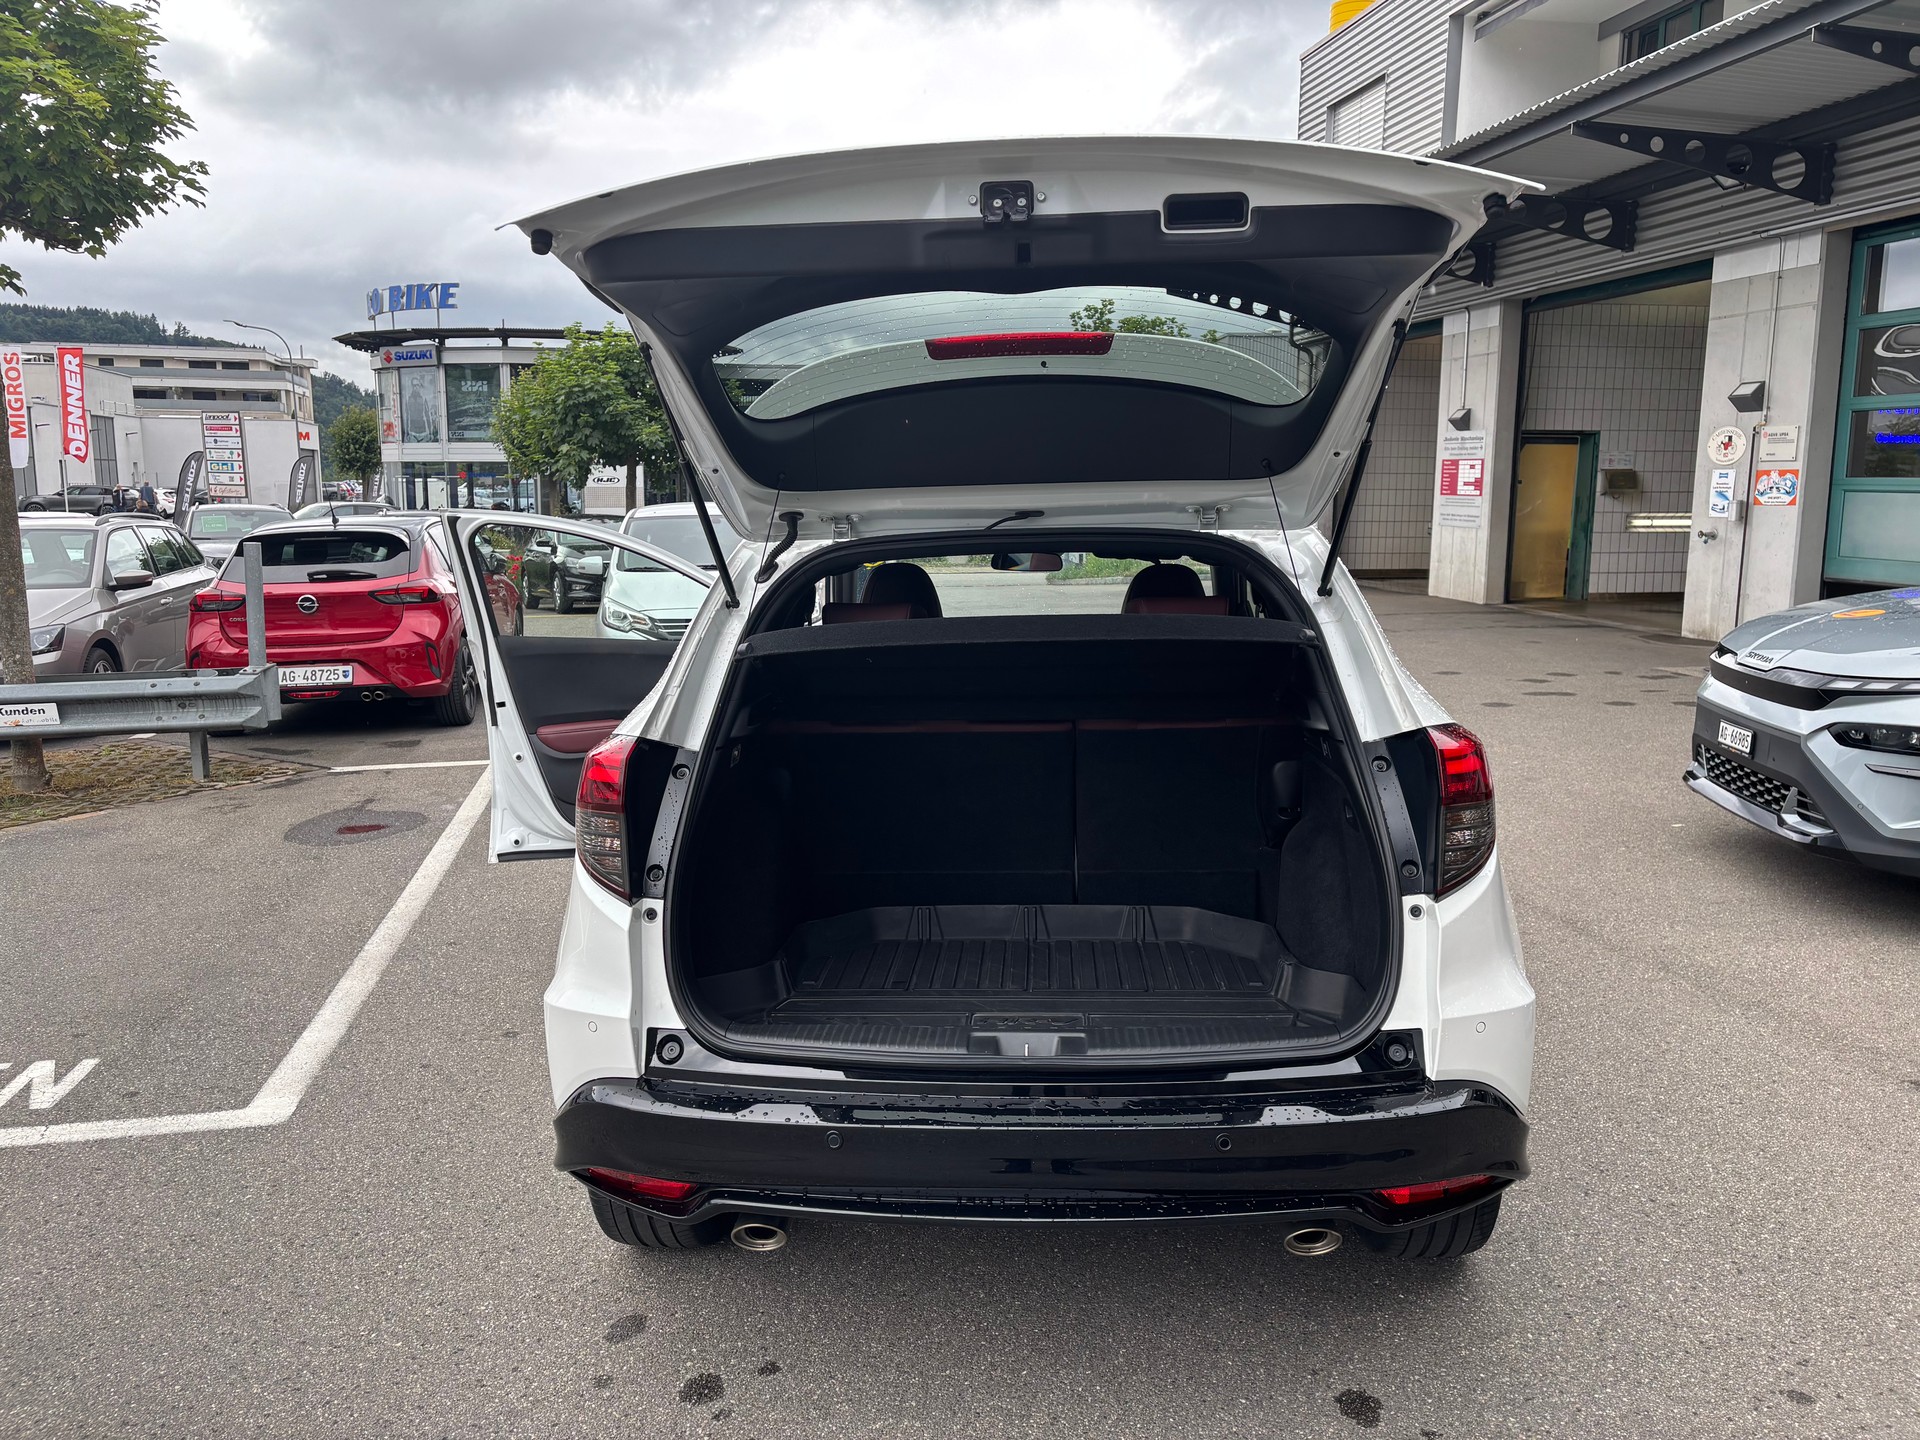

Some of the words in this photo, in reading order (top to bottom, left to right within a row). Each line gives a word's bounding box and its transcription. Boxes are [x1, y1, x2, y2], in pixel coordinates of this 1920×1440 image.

[389, 283, 459, 312] BIKE
[394, 349, 433, 361] SUZUKI
[3, 352, 27, 439] MIGROS
[64, 353, 87, 457] DENNER
[298, 431, 310, 441] M
[182, 459, 197, 511] ZONTES
[295, 463, 307, 503] ZONTES
